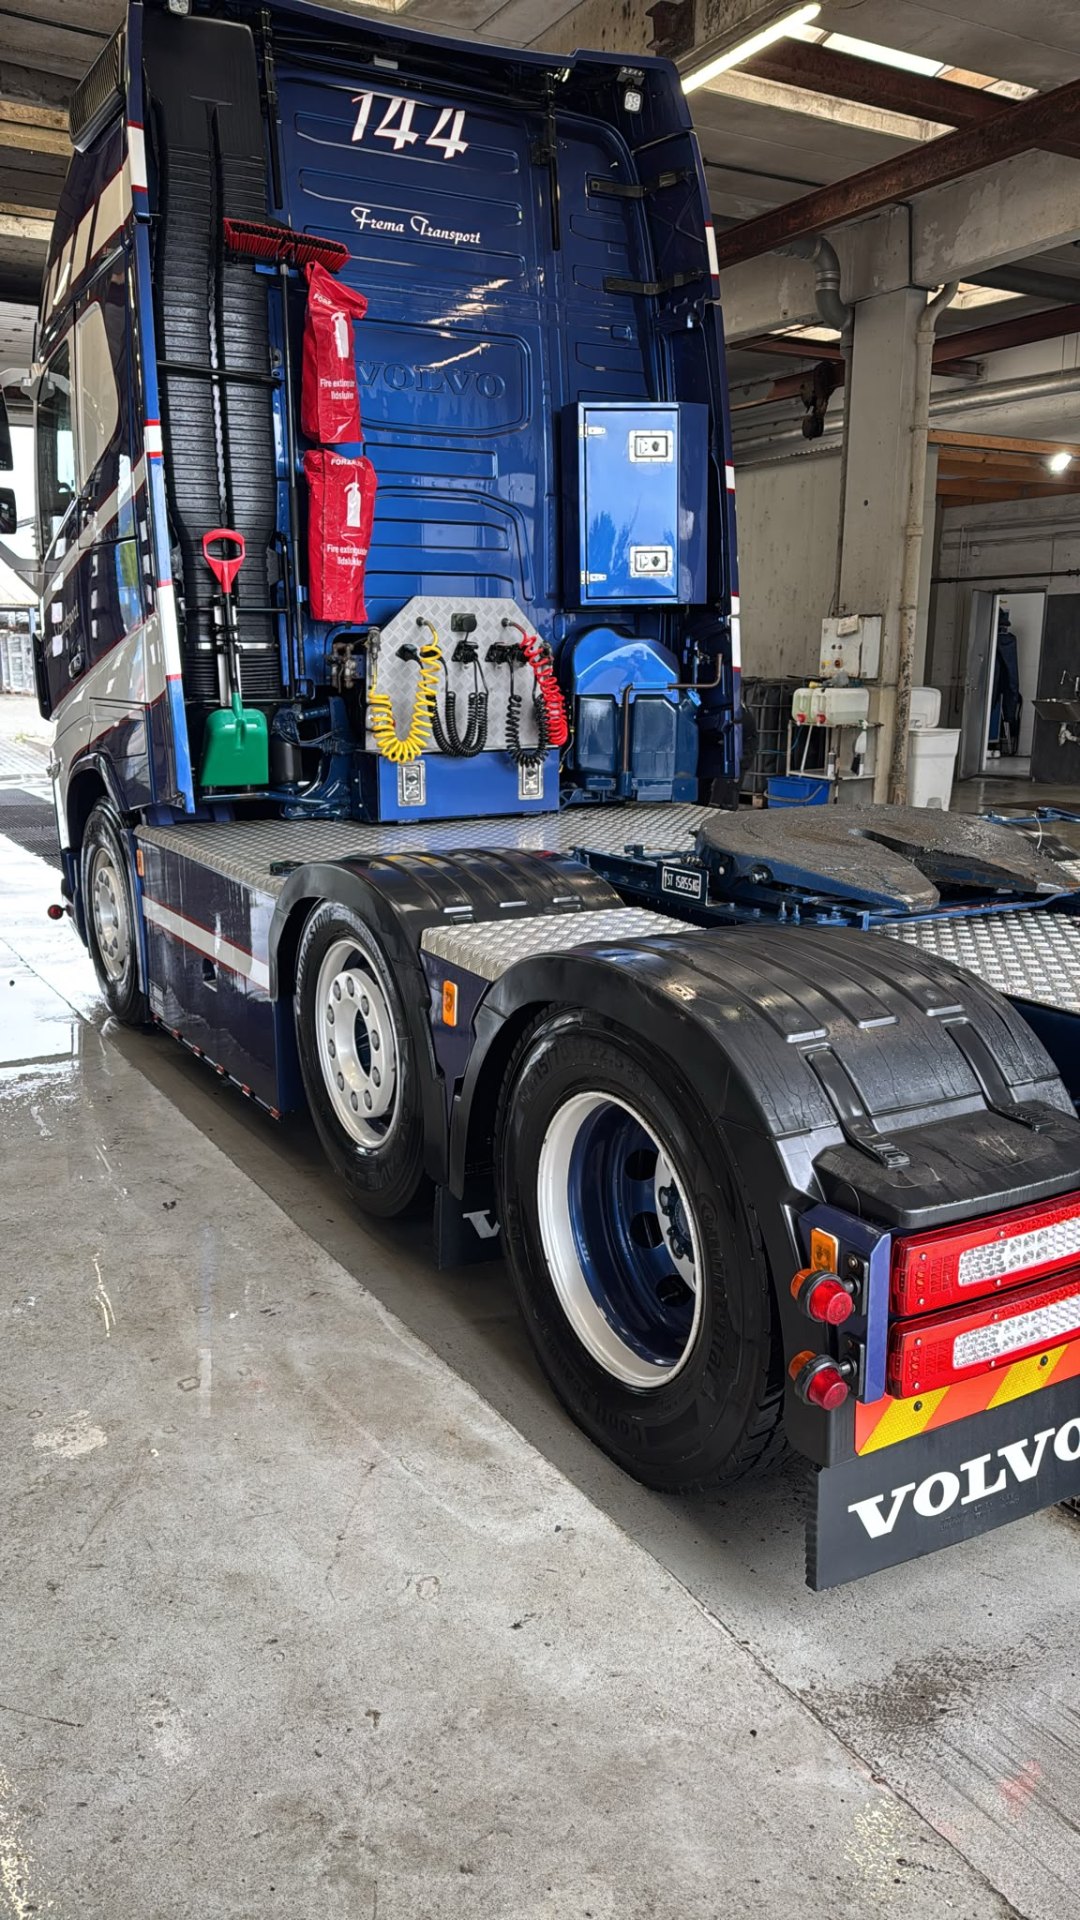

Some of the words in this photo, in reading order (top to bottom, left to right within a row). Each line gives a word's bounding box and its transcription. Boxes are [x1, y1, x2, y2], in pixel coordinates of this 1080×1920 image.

[352, 92, 470, 160] 144
[351, 207, 404, 233] Frema
[410, 216, 481, 245] Transport
[354, 360, 506, 400] VOLVO
[326, 543, 339, 554] Fire
[847, 1417, 1080, 1539] VOLVO
